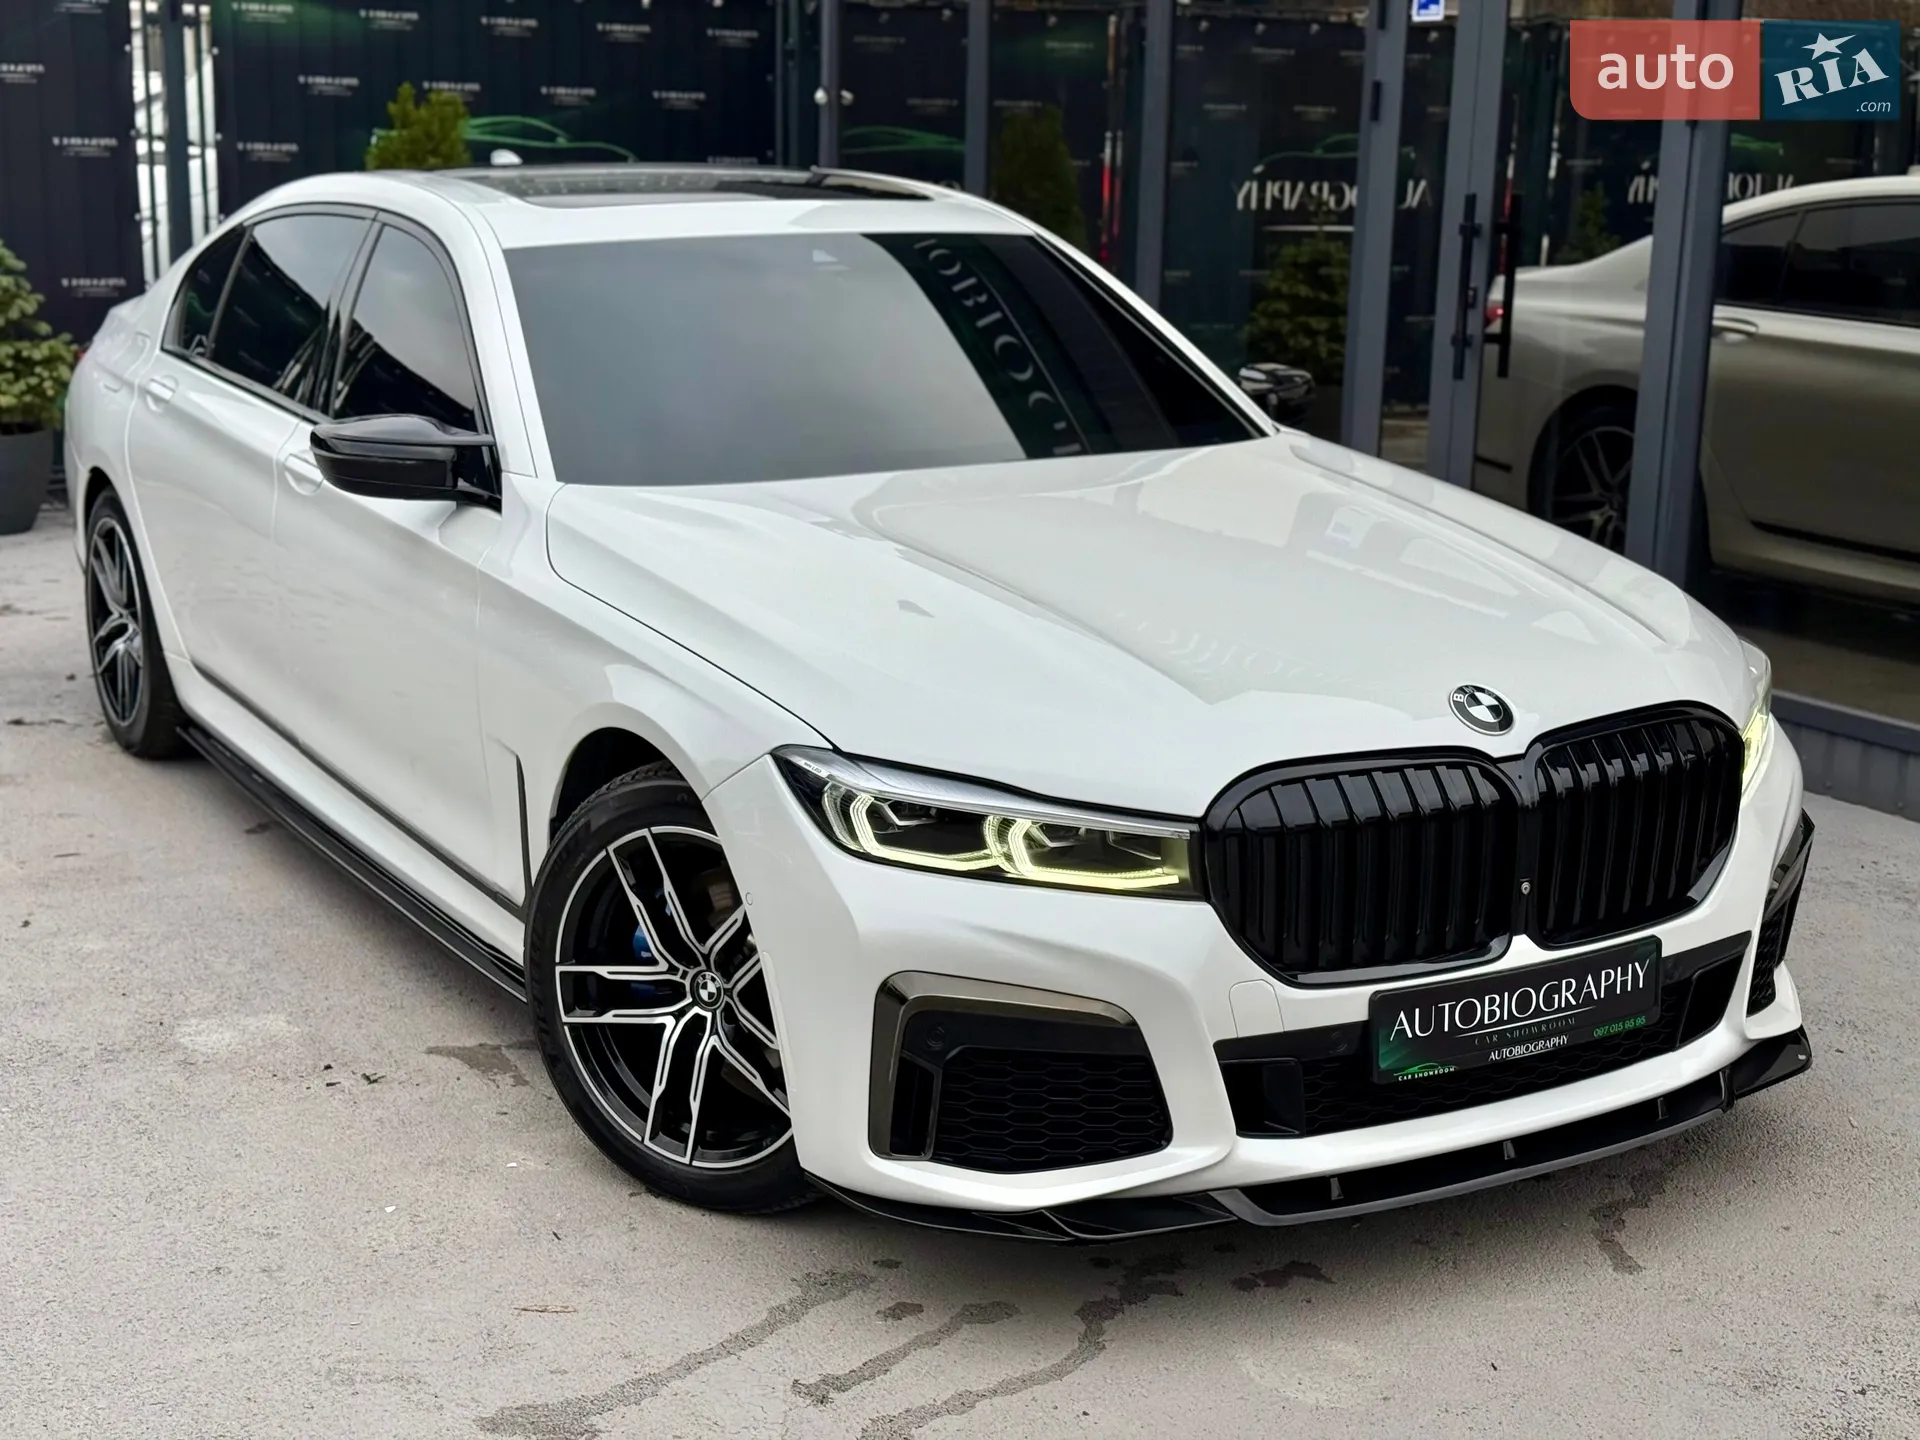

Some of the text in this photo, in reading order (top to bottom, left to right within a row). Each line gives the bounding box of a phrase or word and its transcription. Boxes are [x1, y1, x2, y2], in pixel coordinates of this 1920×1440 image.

[1389, 958, 1650, 1042] AUTOBIOGRAPHY
[1593, 1015, 1646, 1038] 097 015 95 95
[1487, 1034, 1570, 1062] AUTOBIOGRAPHY
[1398, 1067, 1455, 1081] CAR SHOWROOM
